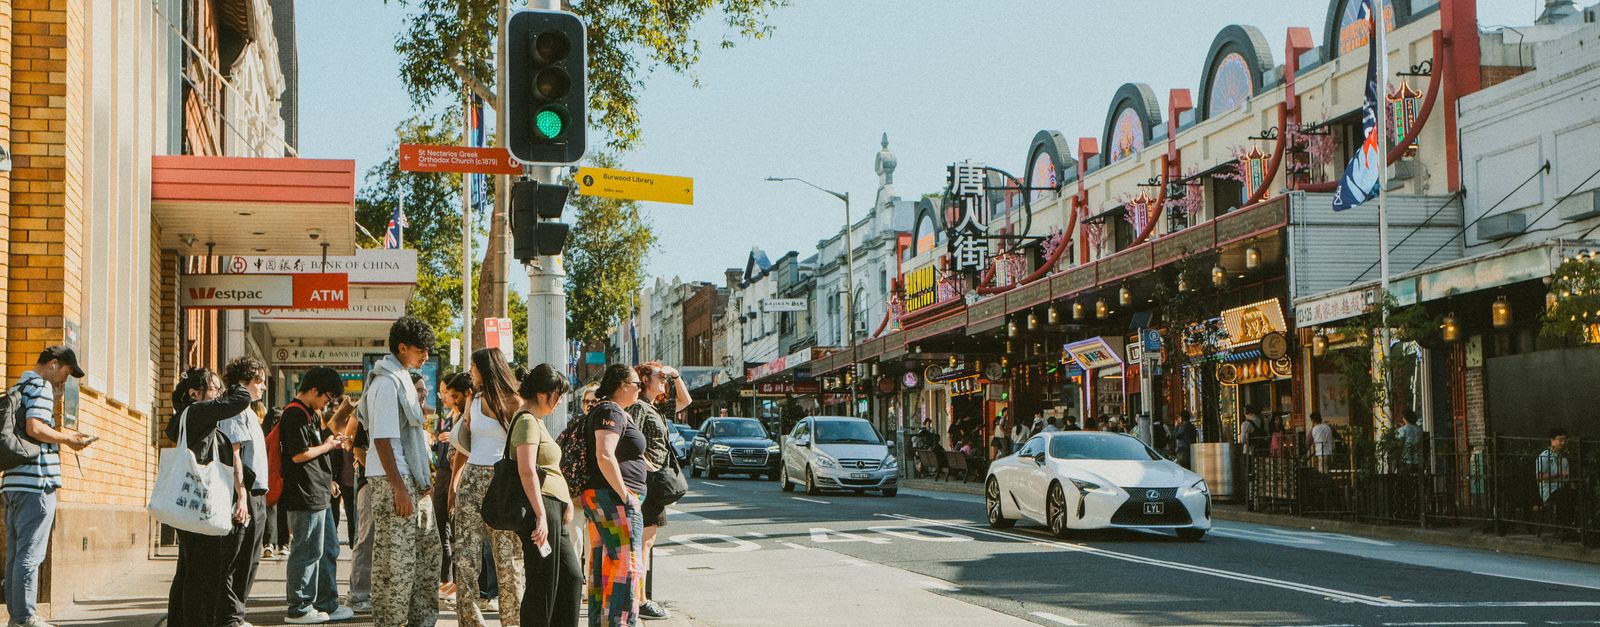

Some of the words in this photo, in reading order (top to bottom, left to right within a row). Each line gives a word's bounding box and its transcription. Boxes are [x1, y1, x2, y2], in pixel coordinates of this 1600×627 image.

[427, 150, 458, 158] Nectarios
[418, 156, 450, 164] Orthodox
[475, 158, 498, 166] (c.1879)
[603, 173, 631, 182] Burwood
[632, 176, 654, 186] Library
[951, 162, 989, 271] 唐人街
[345, 260, 360, 269] OF
[363, 261, 400, 270] CHINA
[188, 286, 263, 301] Westpac
[310, 289, 344, 302] ATM
[352, 304, 365, 313] OF
[366, 304, 398, 313] CHINA
[1146, 504, 1160, 513] LYL
